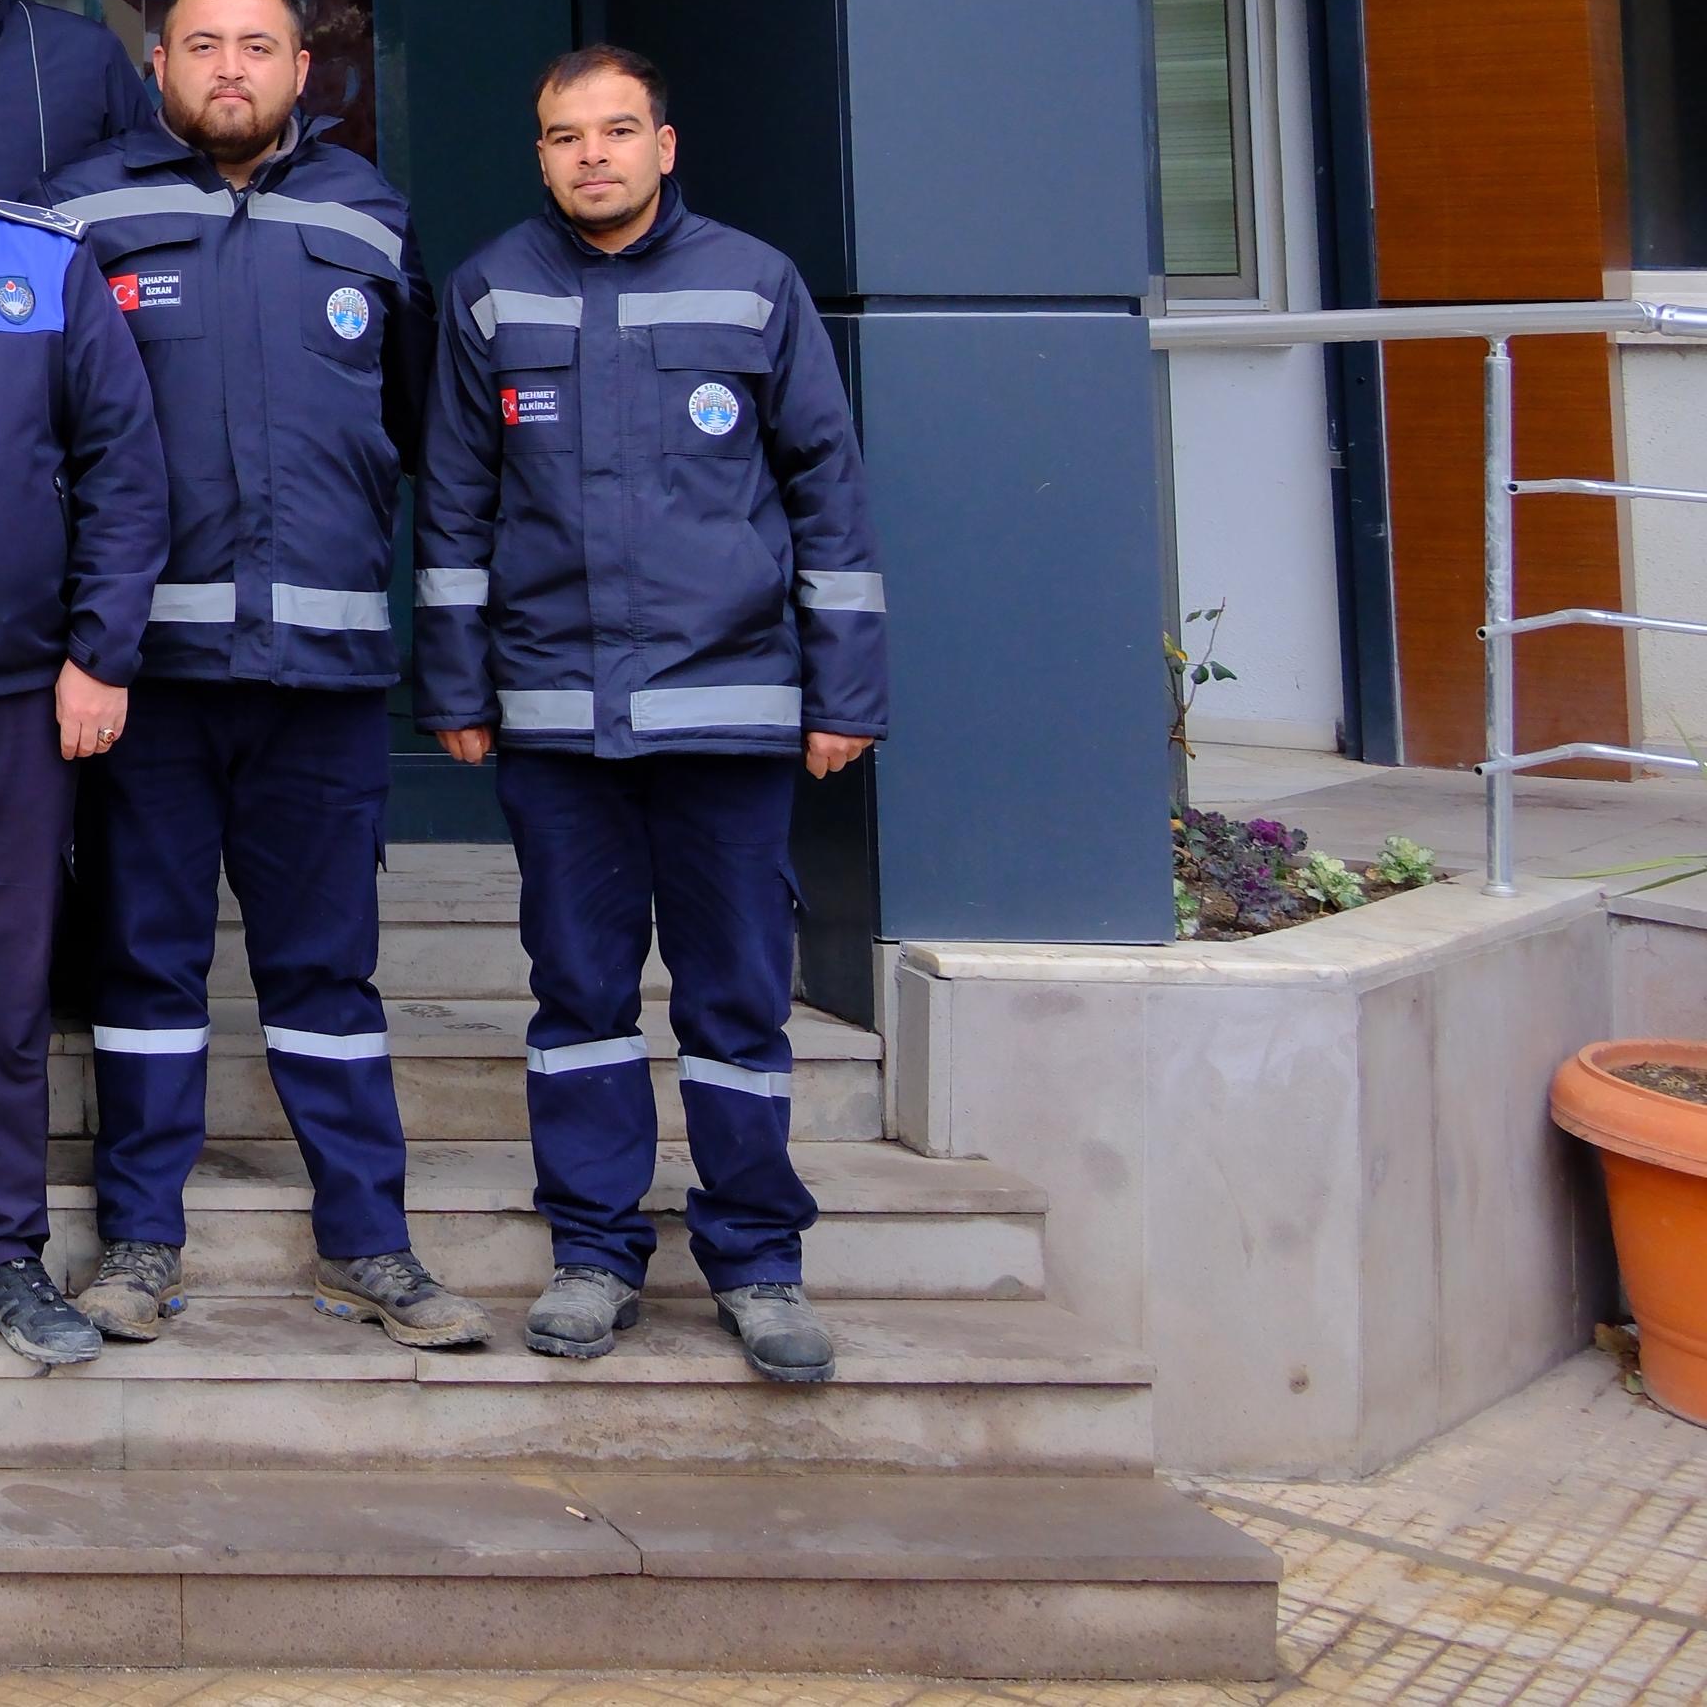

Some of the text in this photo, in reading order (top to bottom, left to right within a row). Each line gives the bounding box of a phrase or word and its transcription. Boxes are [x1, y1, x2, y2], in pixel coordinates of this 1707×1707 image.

[139, 276, 179, 287] ŞAHAPCAN
[146, 286, 171, 295] ÖZKAN
[518, 391, 555, 400] MEHMET
